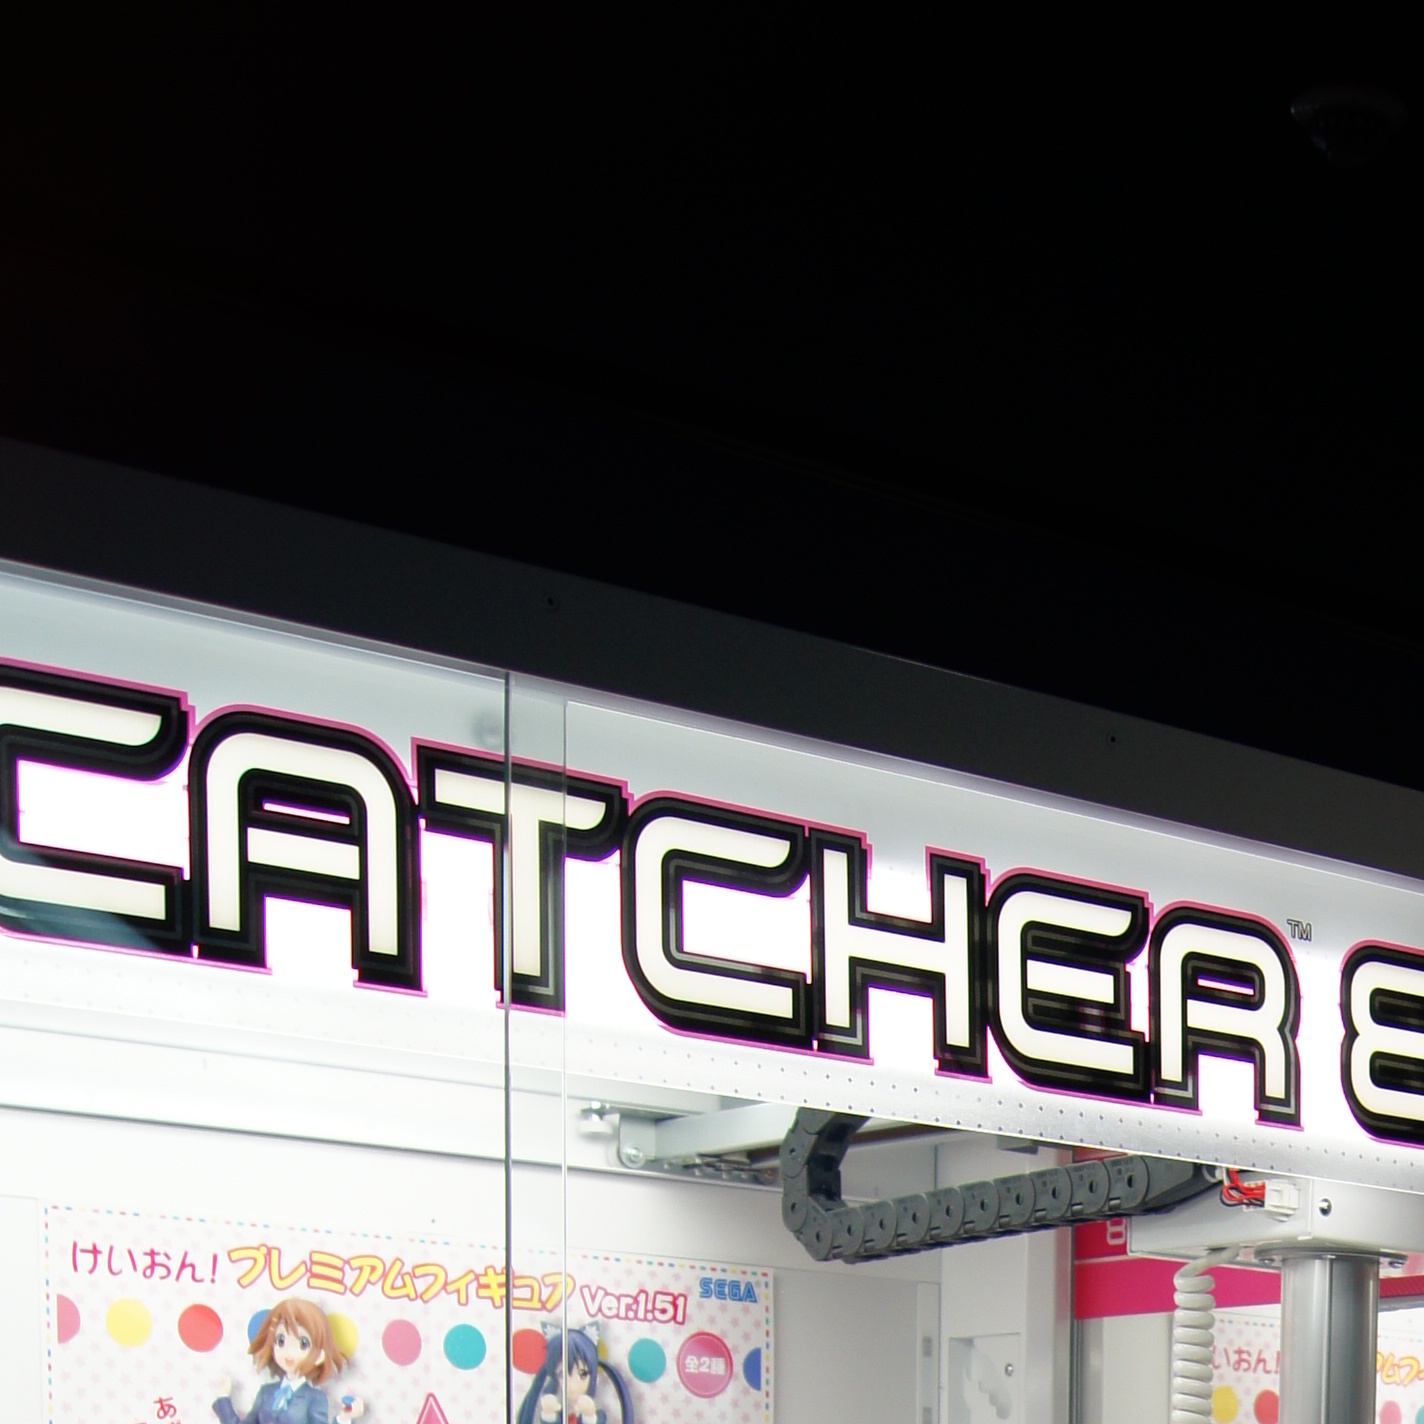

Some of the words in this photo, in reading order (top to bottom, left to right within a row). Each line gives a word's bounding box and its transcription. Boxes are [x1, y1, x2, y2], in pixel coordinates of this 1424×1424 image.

[0, 657, 1303, 1130] CATCHER
[227, 1243, 576, 1312] プレミアムフィギュア
[581, 1284, 687, 1325] Ver.1.51
[699, 1276, 758, 1304] SEGA
[1209, 1347, 1281, 1376] いおん!
